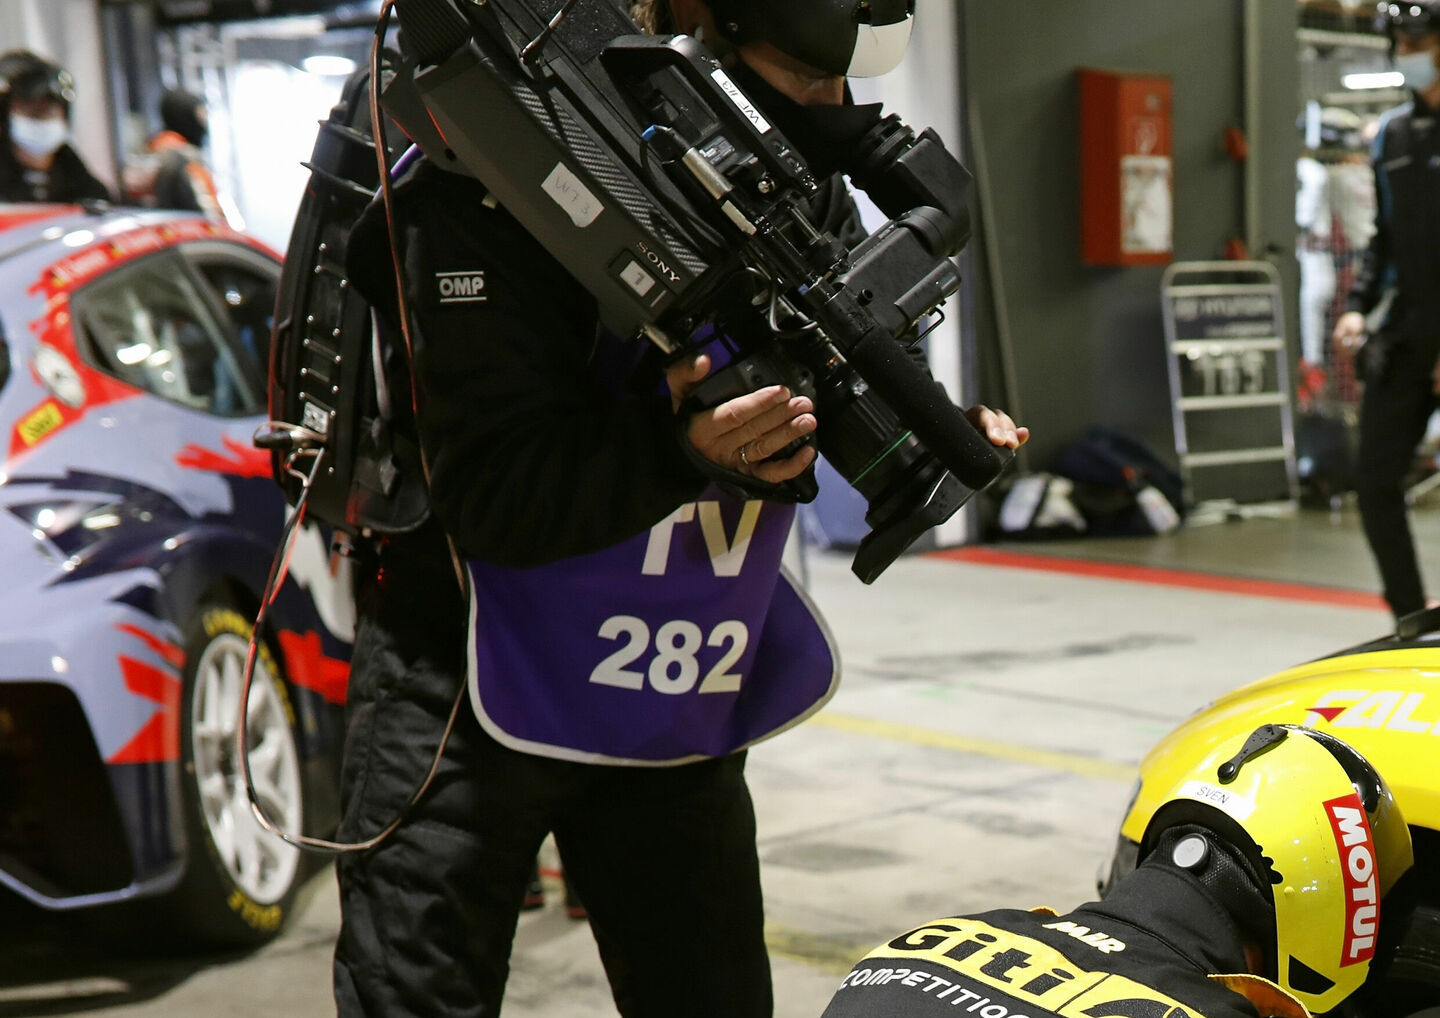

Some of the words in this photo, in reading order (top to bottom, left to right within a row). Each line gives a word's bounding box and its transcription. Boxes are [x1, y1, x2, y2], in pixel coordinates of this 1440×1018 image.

[636, 241, 681, 283] SONY
[439, 275, 485, 298] OMP
[589, 615, 750, 695] 282
[1196, 787, 1231, 805] SVEN
[1332, 805, 1377, 959] MOTUL
[1042, 921, 1127, 955] MIR
[888, 924, 1076, 997] Giti
